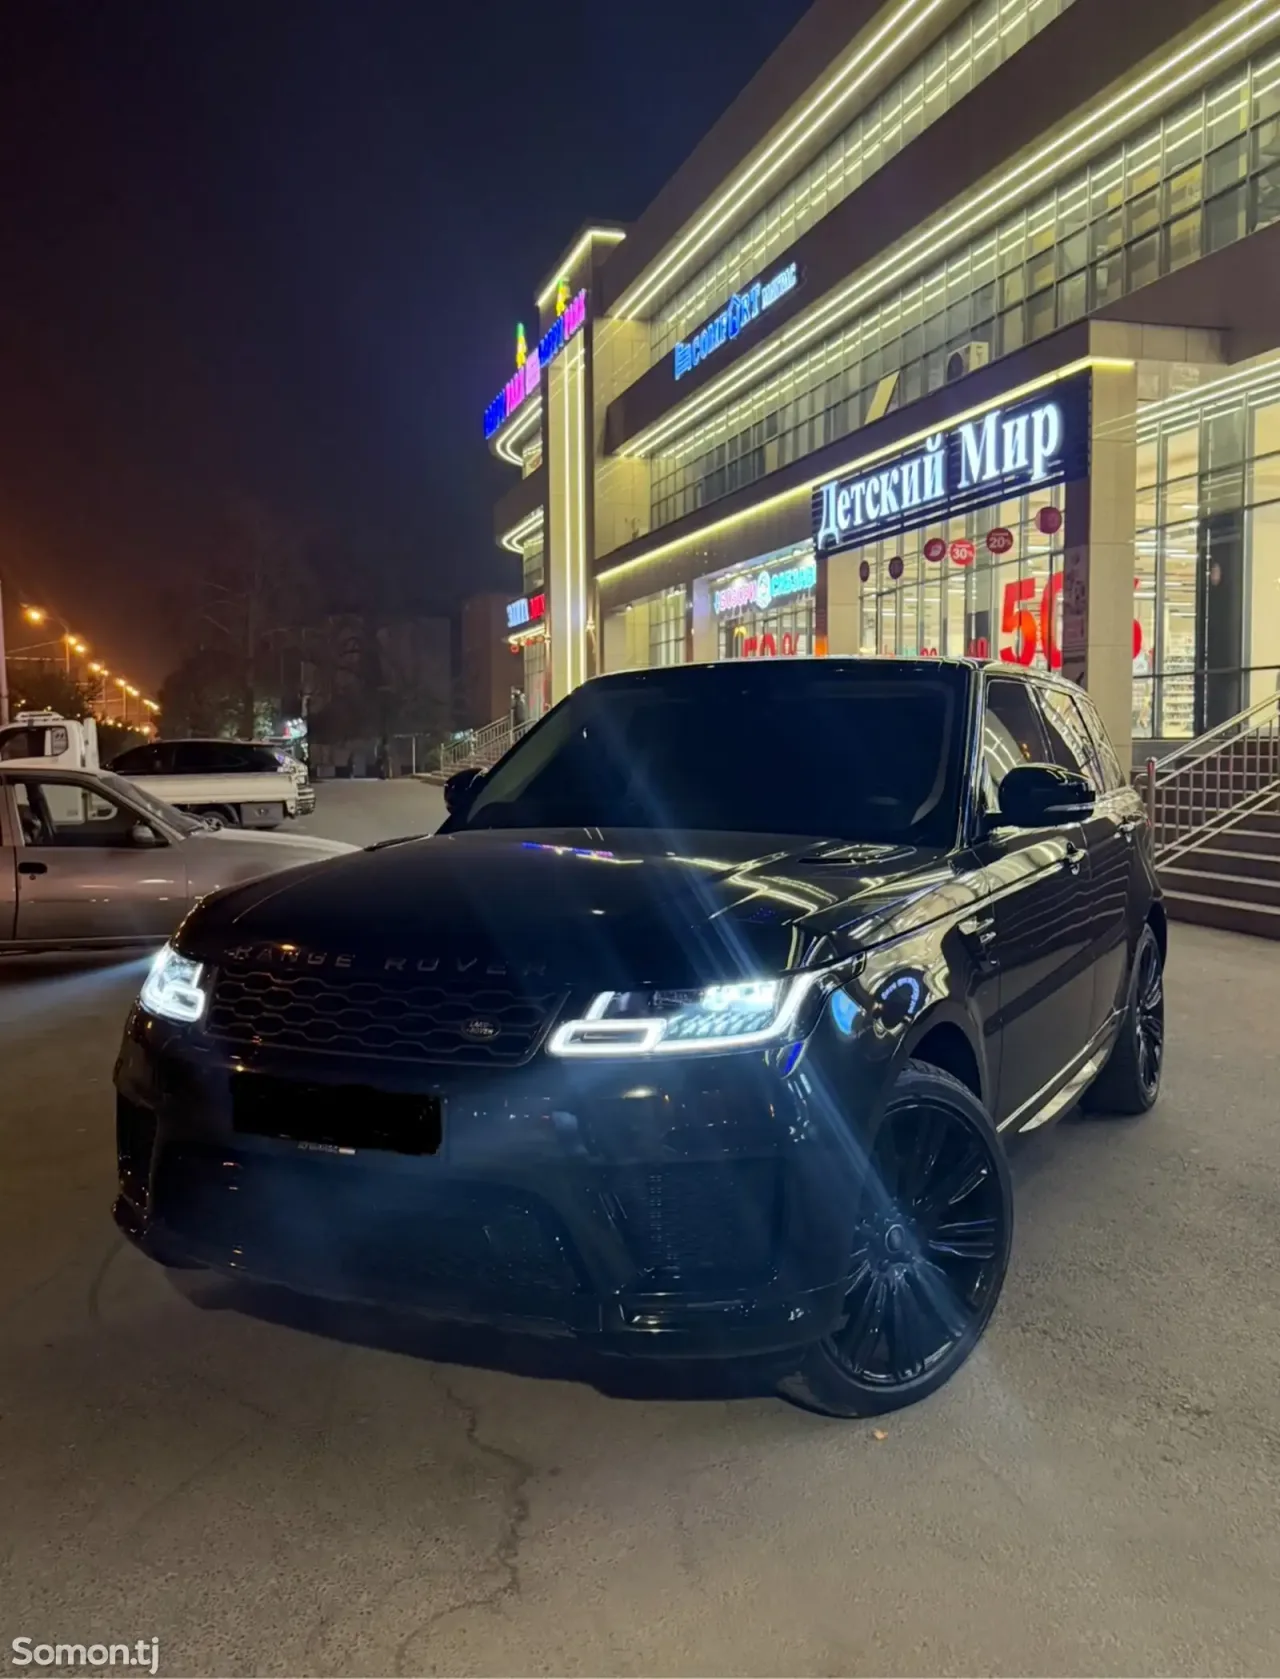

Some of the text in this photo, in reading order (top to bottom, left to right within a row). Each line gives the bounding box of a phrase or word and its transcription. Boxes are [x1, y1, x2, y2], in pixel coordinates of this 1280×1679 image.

[817, 403, 1062, 550] Детский Мир
[233, 946, 547, 977] RANGE ROVER
